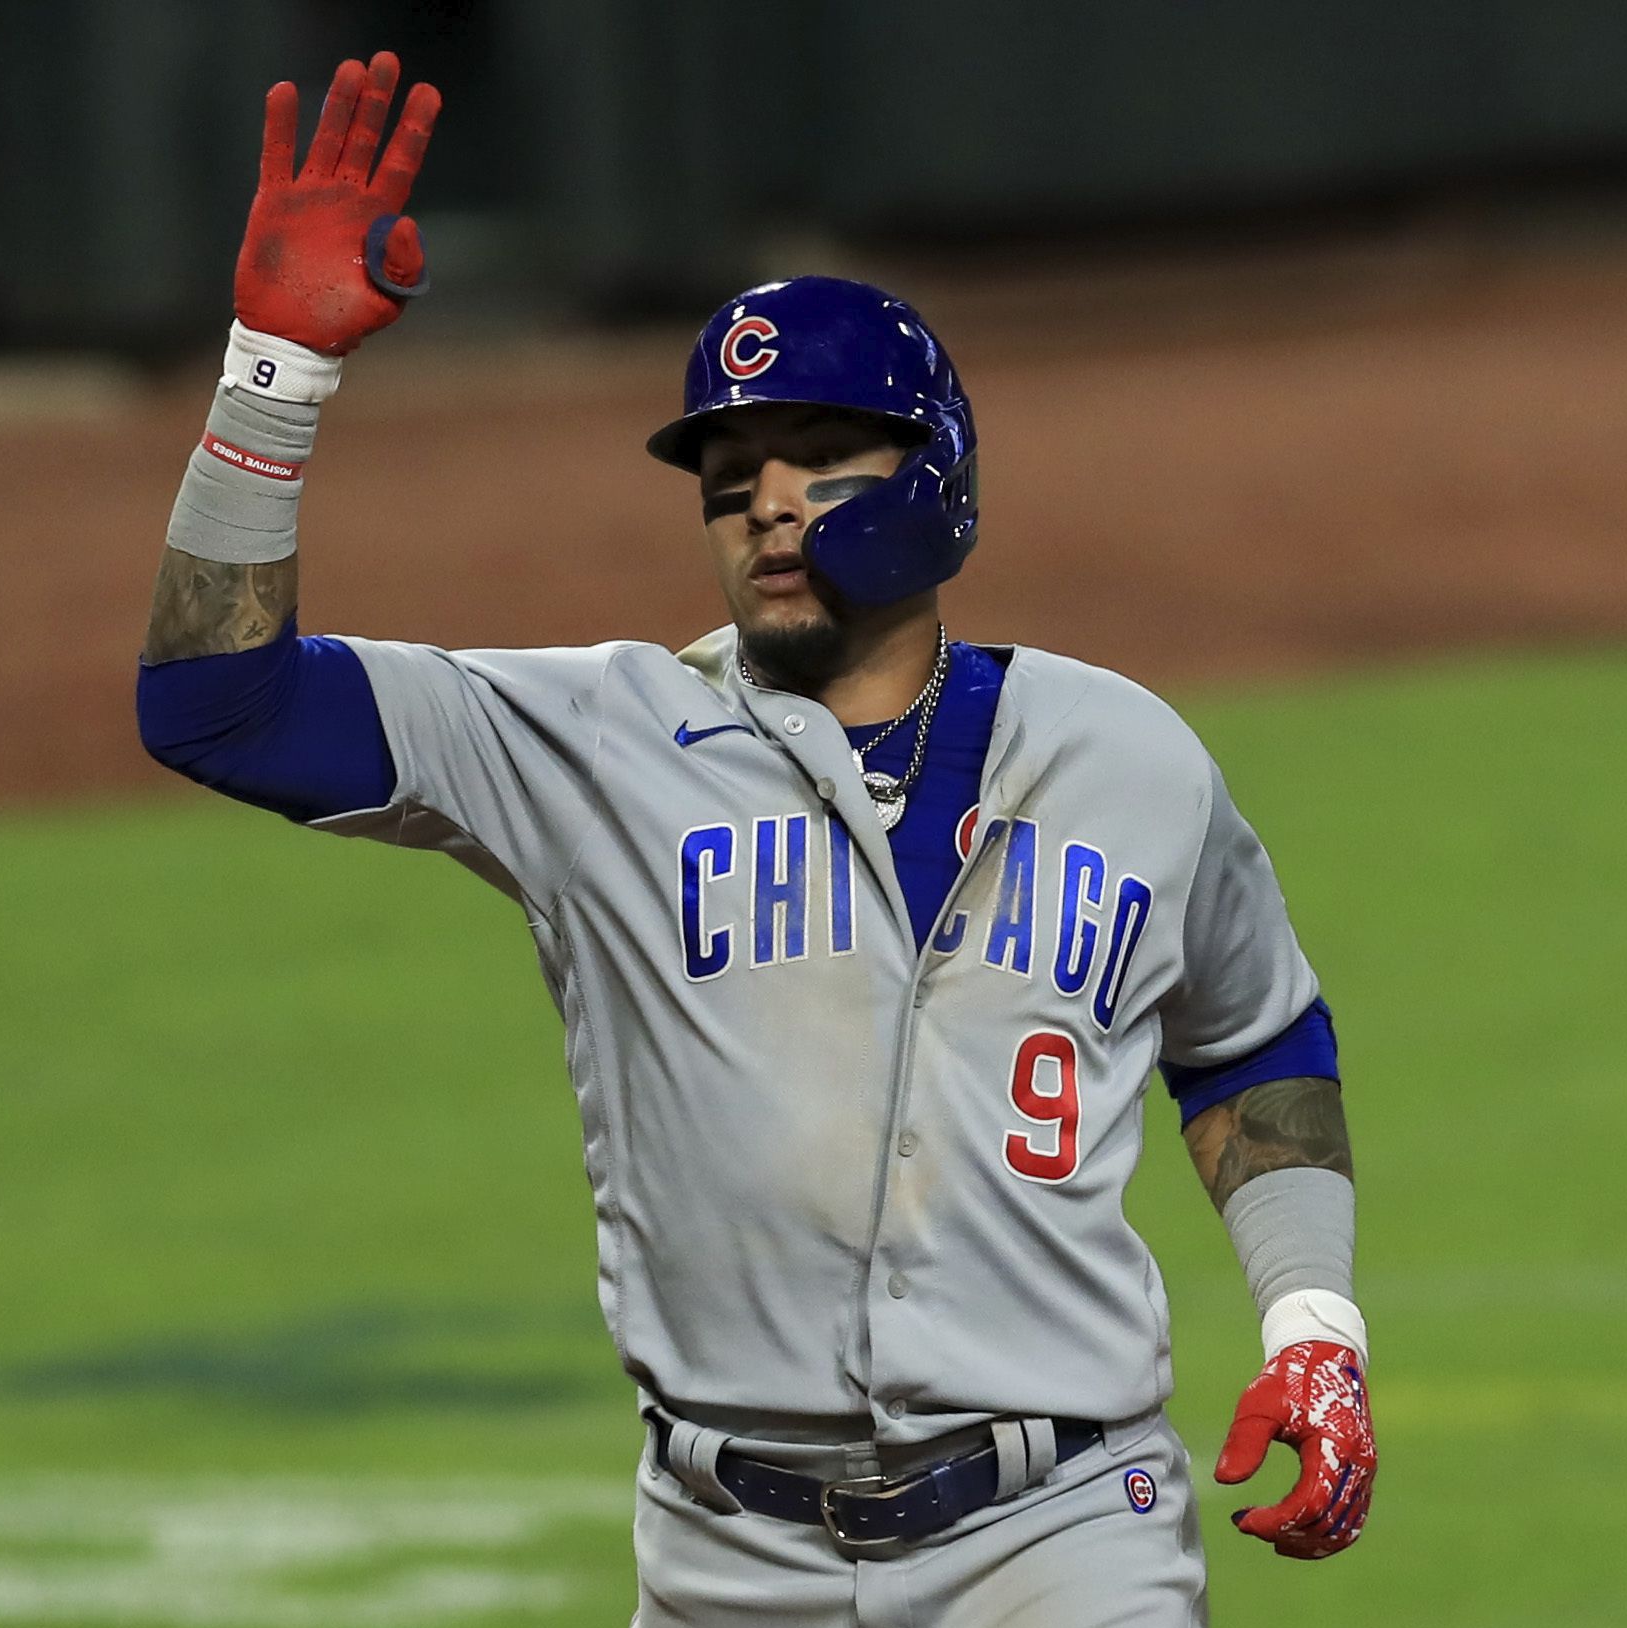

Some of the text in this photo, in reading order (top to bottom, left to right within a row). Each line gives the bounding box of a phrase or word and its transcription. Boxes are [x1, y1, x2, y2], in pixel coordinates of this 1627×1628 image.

[720, 316, 779, 380] C
[253, 359, 276, 389] 9
[212, 441, 293, 476] POSITIVE VIBES
[1003, 1028, 1082, 1186] 9
